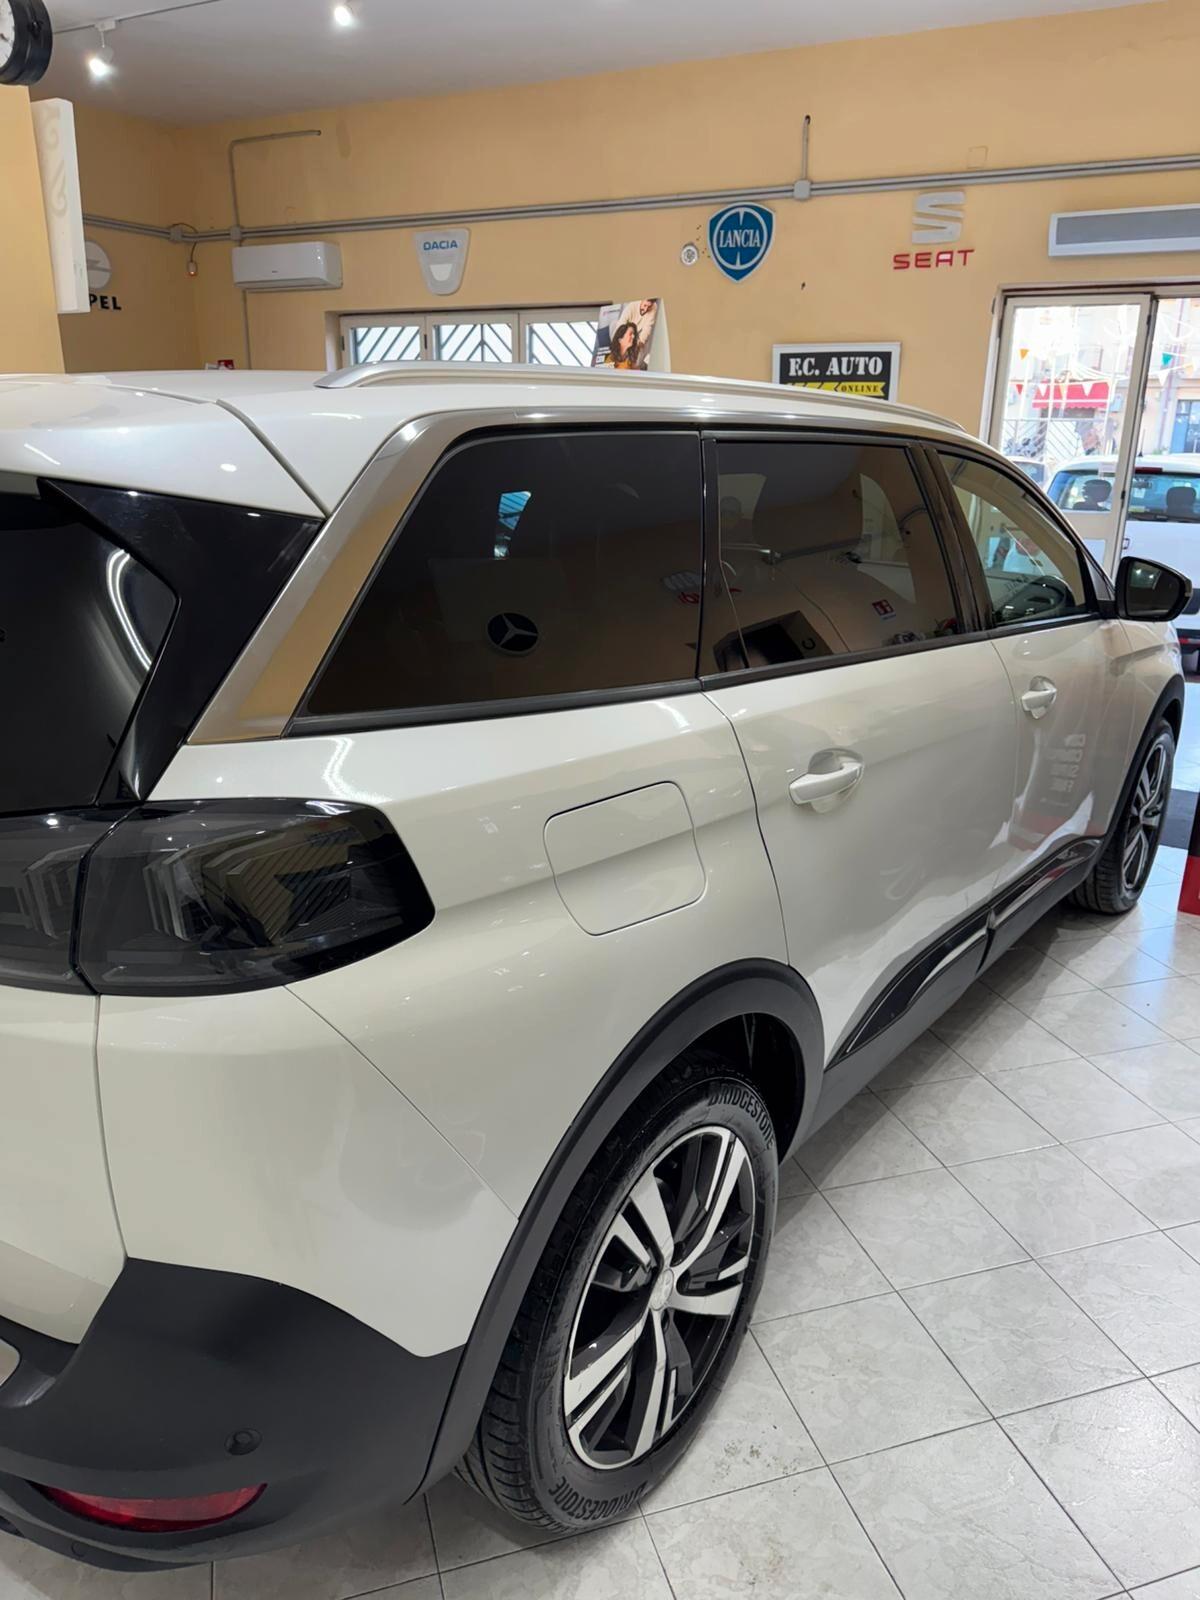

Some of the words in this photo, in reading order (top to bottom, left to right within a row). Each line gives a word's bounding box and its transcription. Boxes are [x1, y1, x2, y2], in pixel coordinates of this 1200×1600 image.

[423, 240, 458, 251] DACIA
[719, 228, 761, 248] LANCIA
[893, 249, 975, 270] SEAT
[89, 293, 122, 311] PEL
[788, 357, 820, 377] F.C.
[826, 356, 883, 376] AUTO
[840, 384, 879, 393] ONLINE
[708, 1084, 775, 1150] BRIDGESTONE
